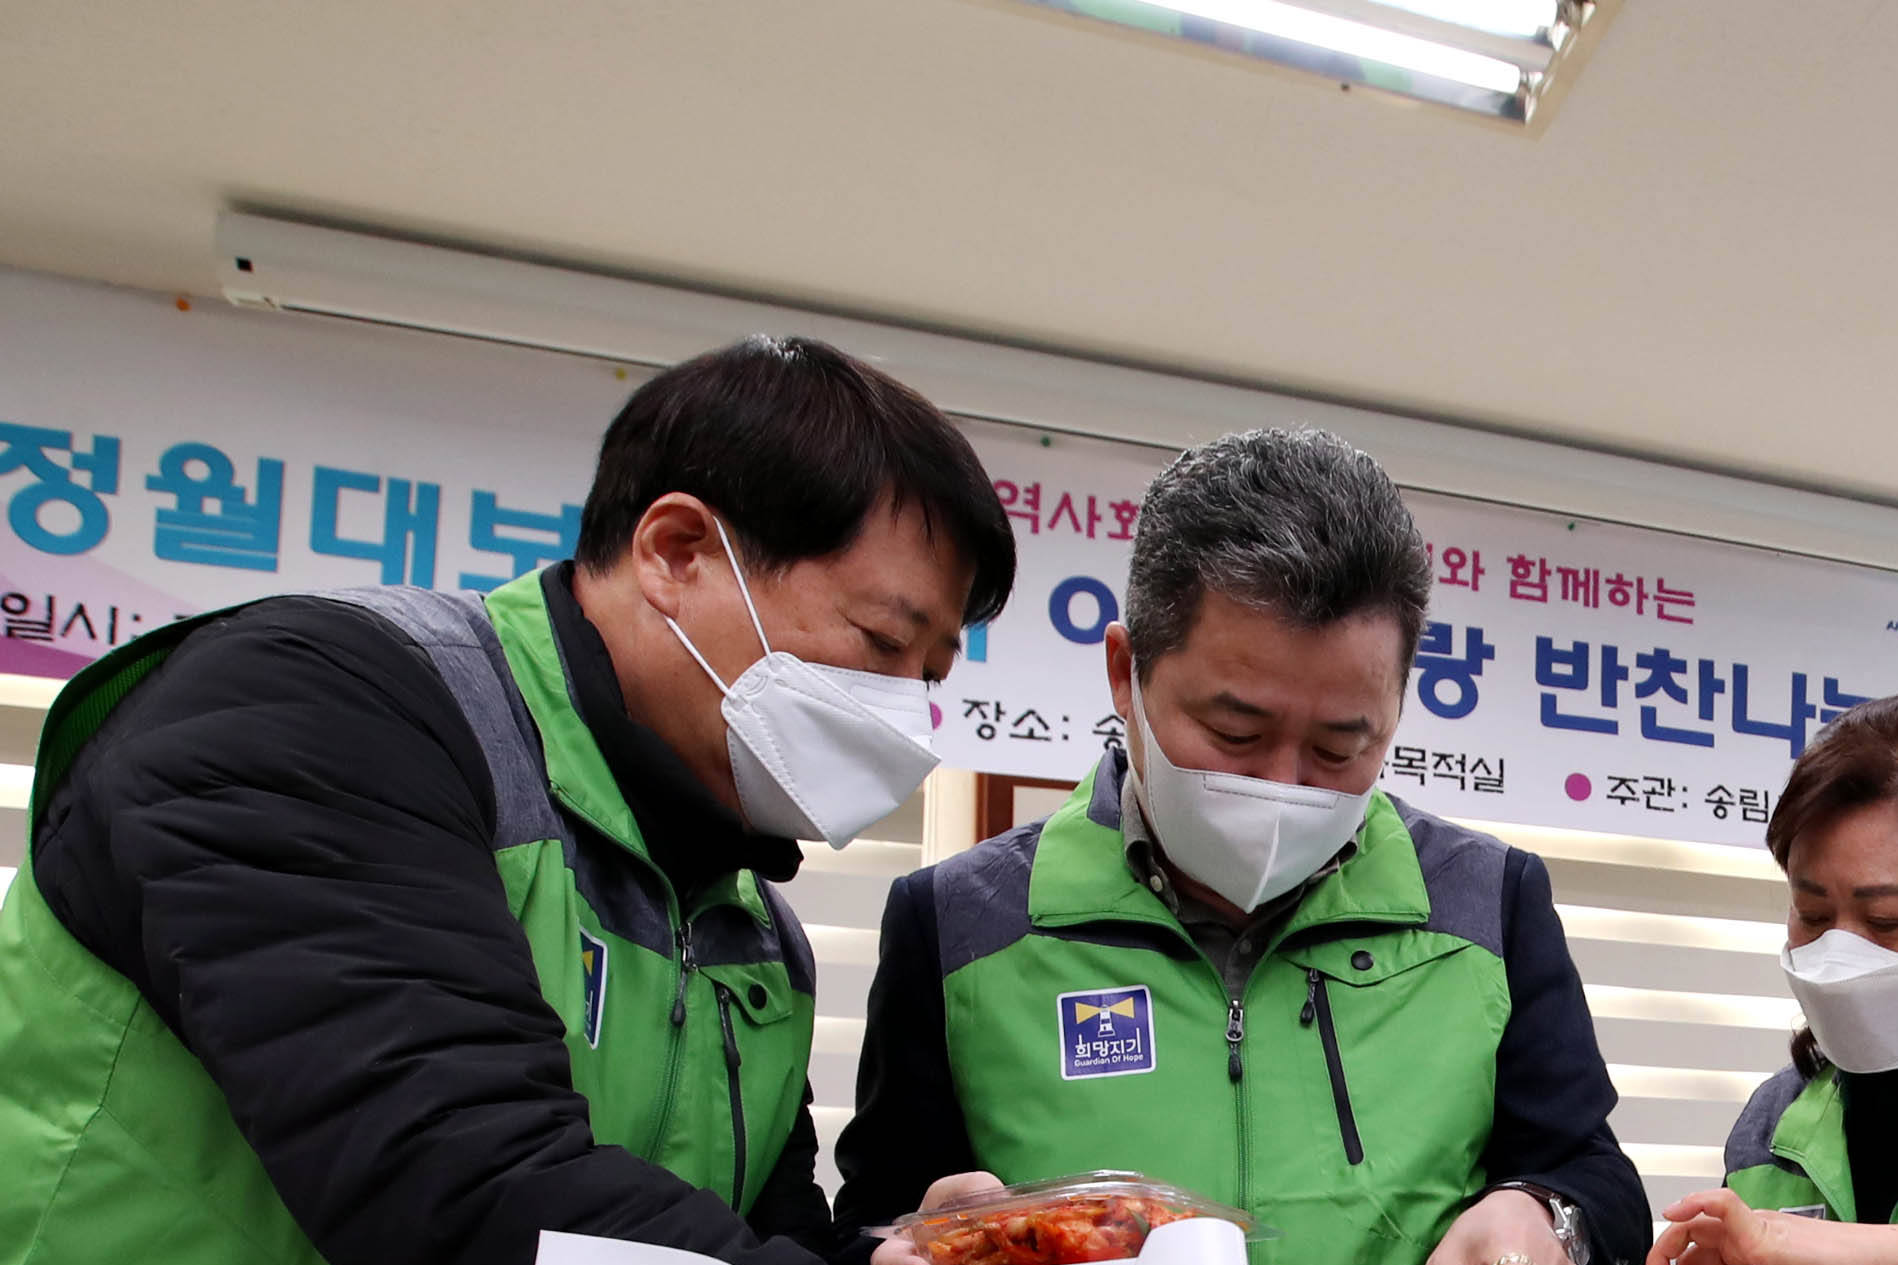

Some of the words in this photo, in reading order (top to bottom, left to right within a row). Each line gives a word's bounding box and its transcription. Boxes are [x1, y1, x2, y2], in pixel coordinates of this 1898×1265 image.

[1425, 543, 1485, 591] 와
[1506, 554, 1697, 625] 함께하는
[962, 697, 1070, 742] 장소:
[1374, 745, 1505, 794] 목적실
[1605, 774, 1689, 813] 주관:
[1075, 1027, 1142, 1059] 희망지기
